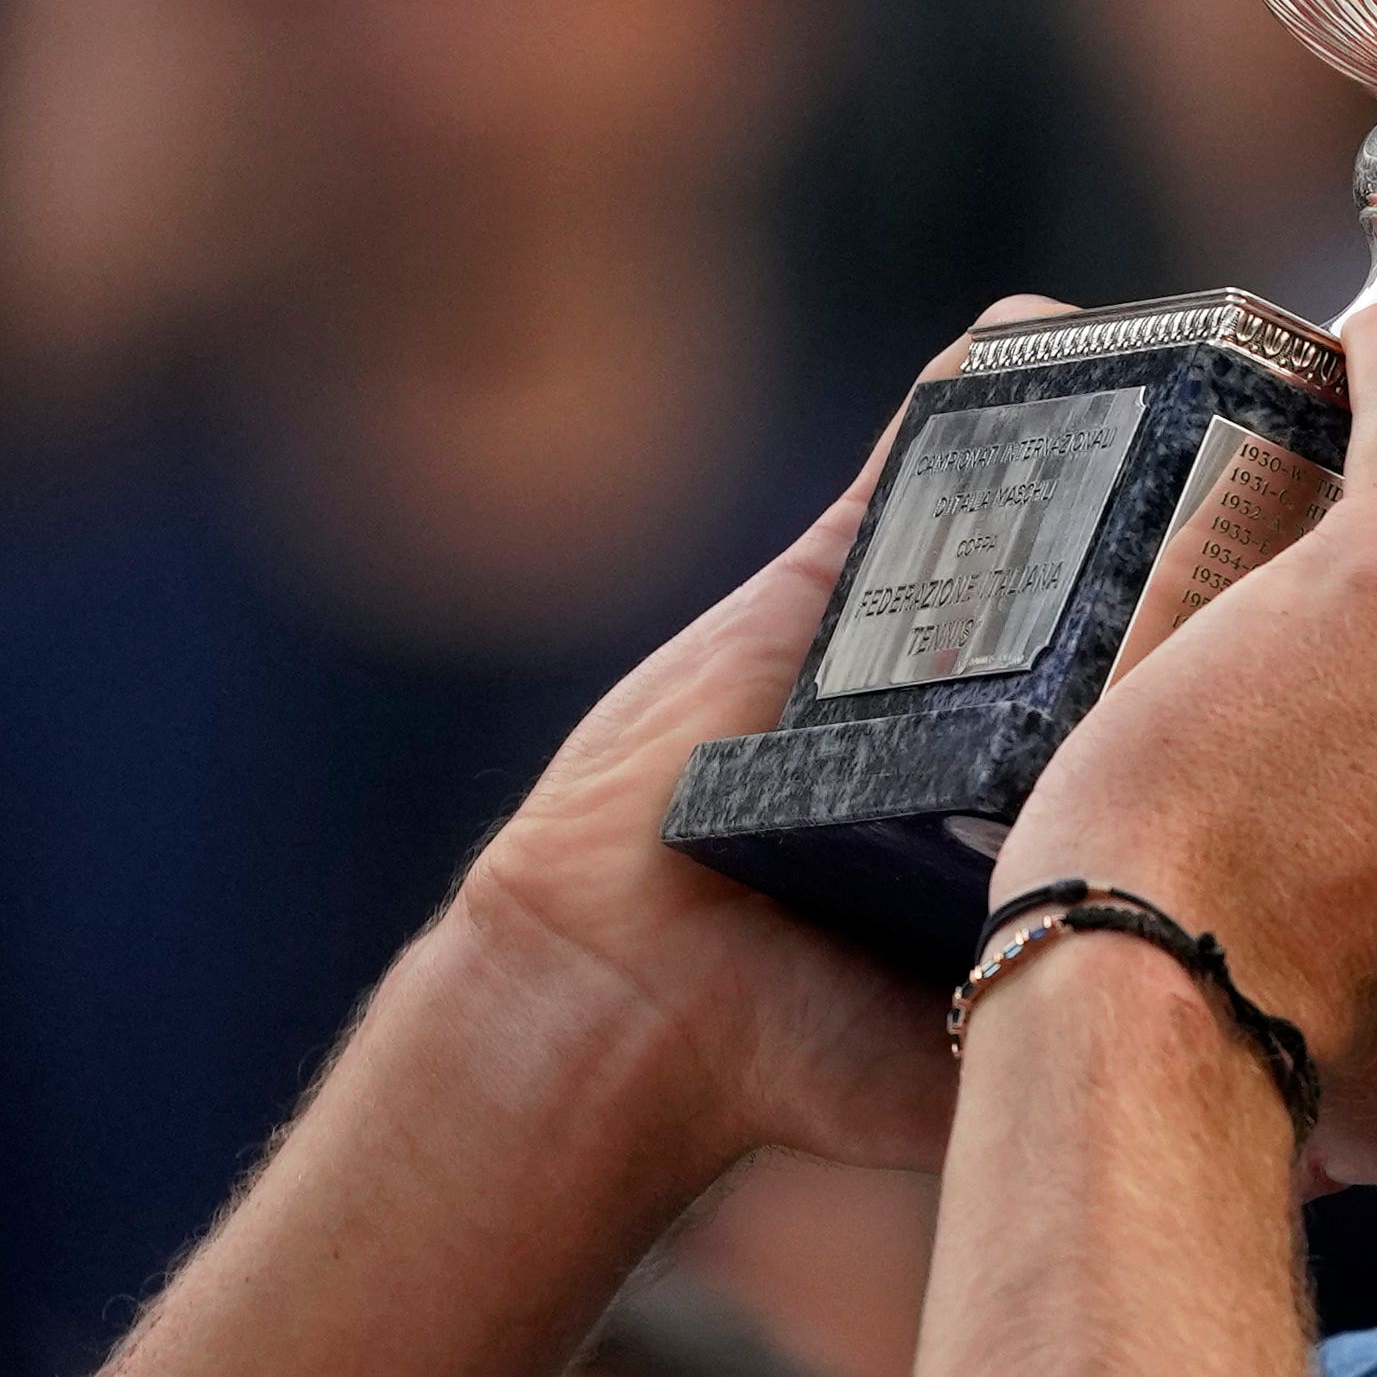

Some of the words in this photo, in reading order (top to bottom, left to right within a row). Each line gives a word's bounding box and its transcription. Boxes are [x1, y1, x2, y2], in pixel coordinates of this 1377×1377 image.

[915, 443, 1000, 475] CAMPIONATI
[1000, 427, 1117, 464] INTERNAZIONALI
[994, 480, 1057, 508] MASCHILI
[1316, 479, 1344, 503] TID
[955, 534, 997, 558] COPPA
[1202, 540, 1260, 571] 1934-
[855, 572, 979, 618] FEDERAZIONE
[979, 560, 1064, 600] ITALIANA
[907, 618, 975, 656] TENNIS
